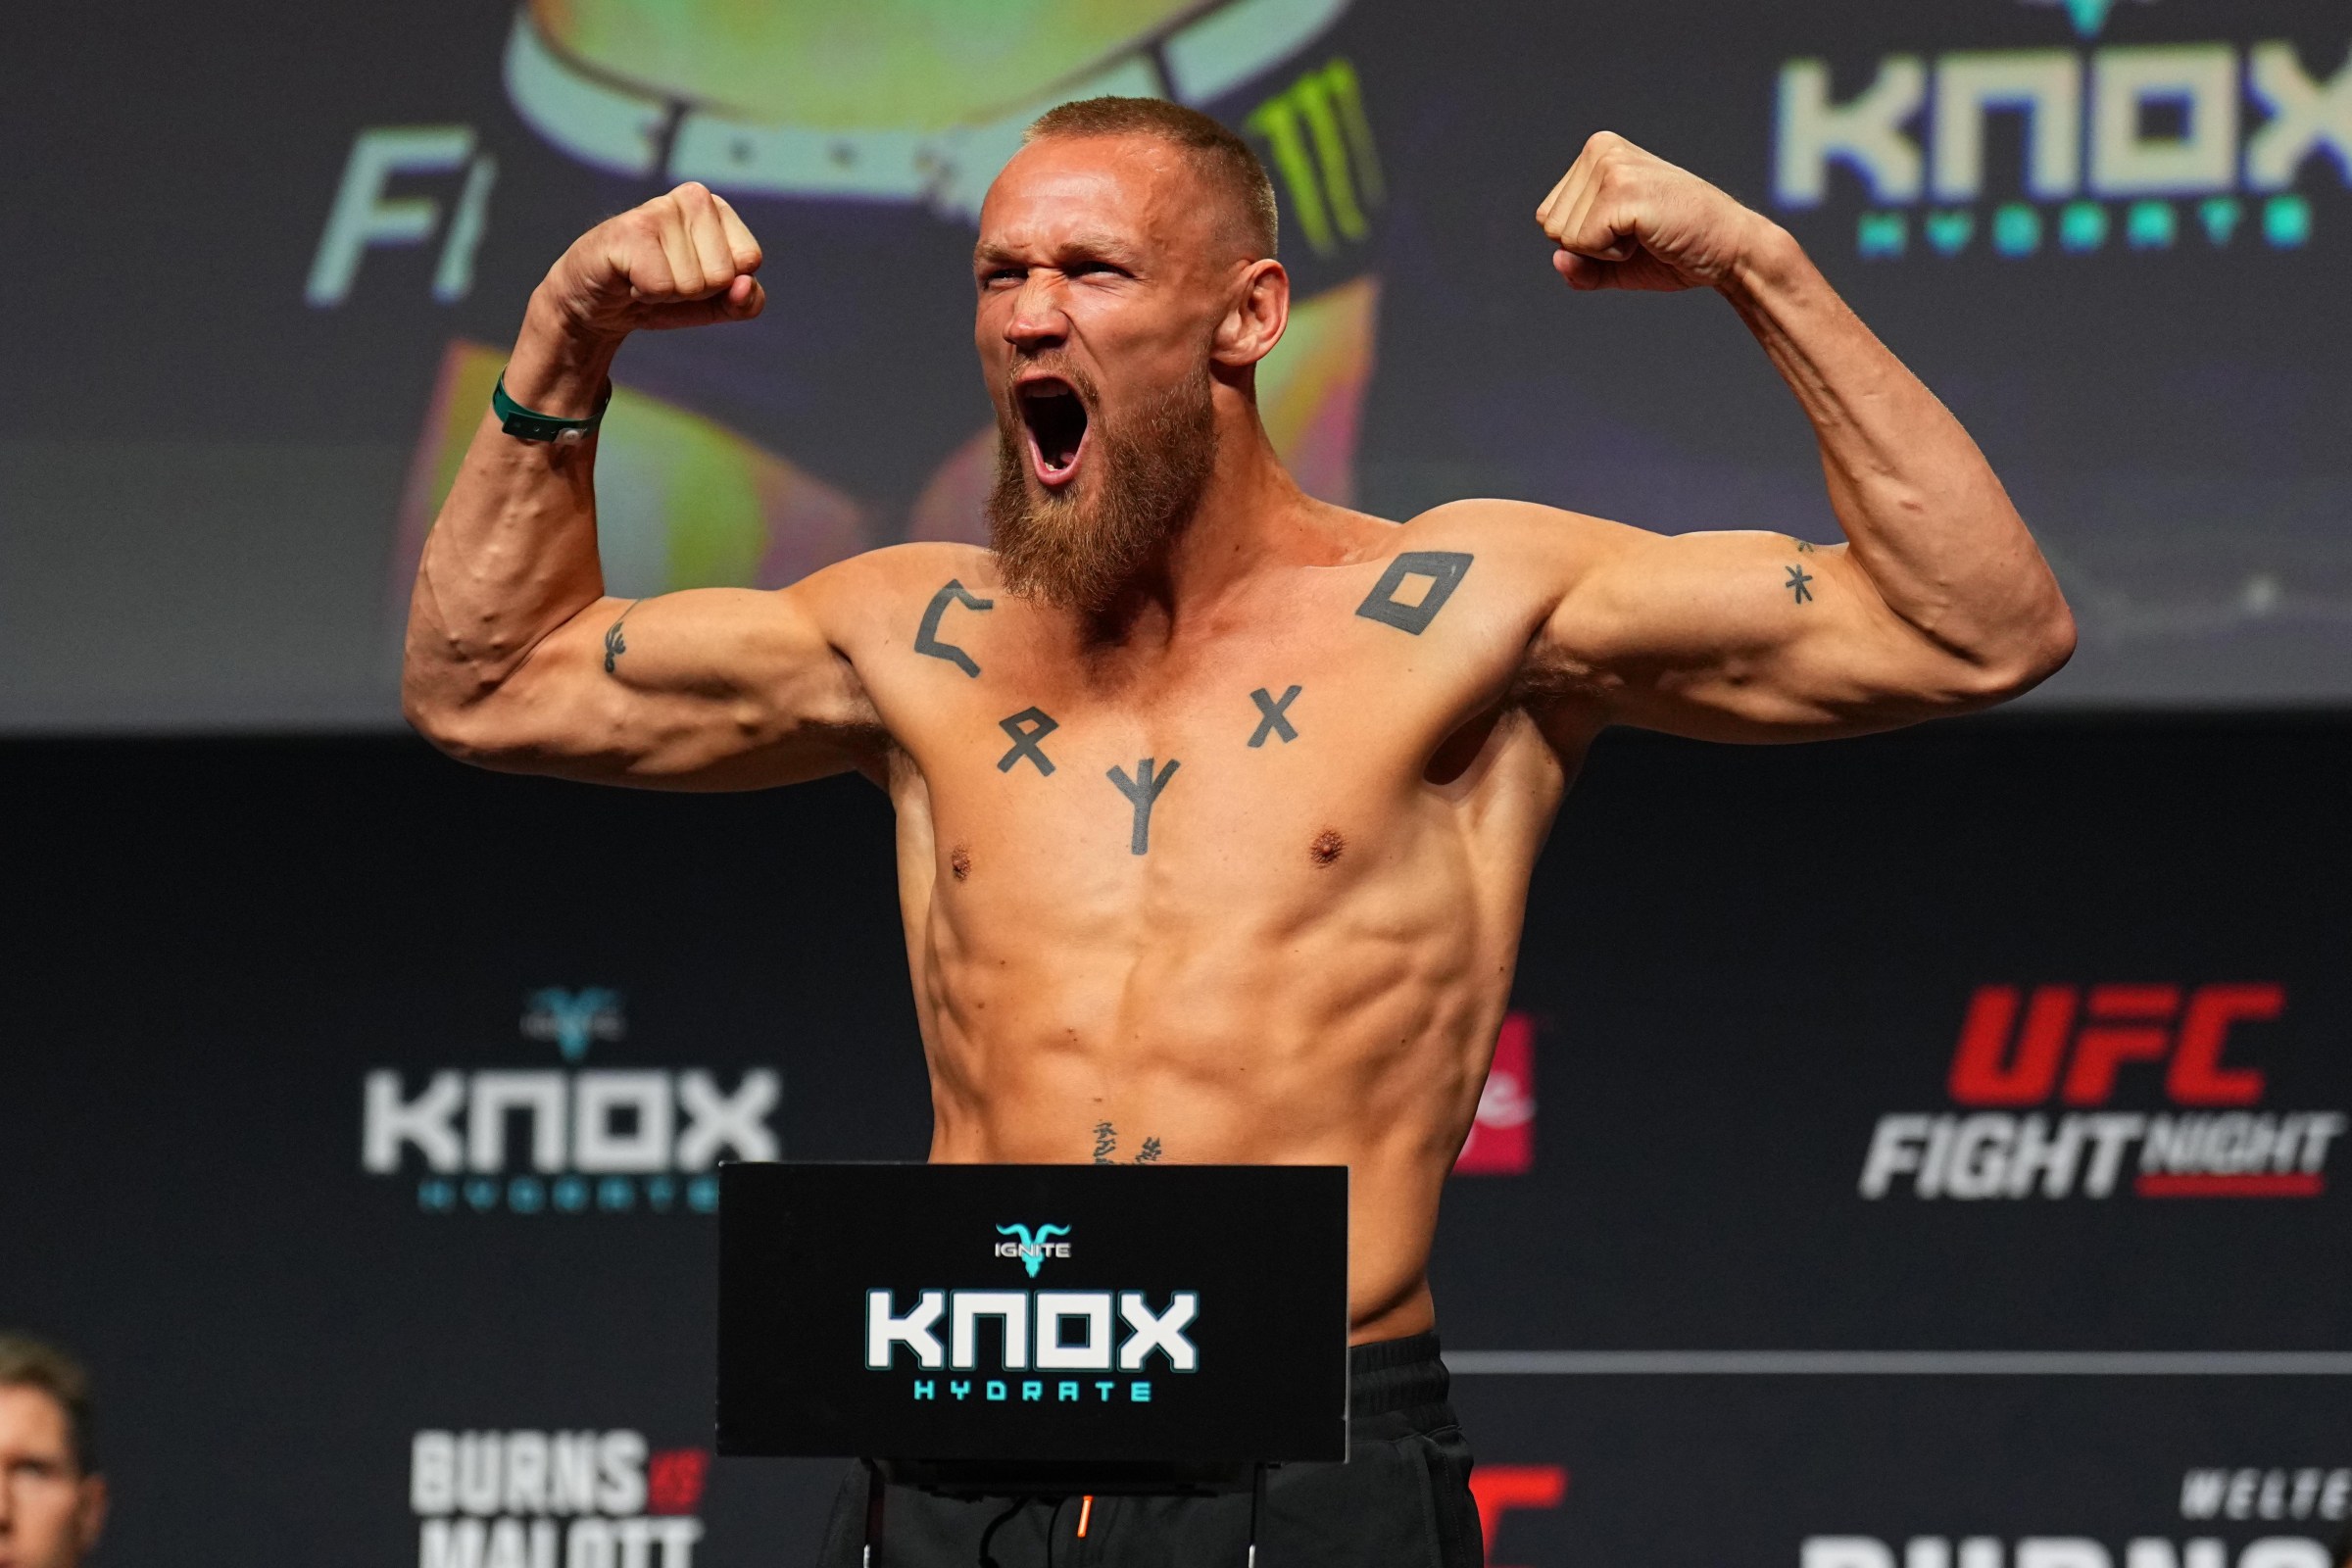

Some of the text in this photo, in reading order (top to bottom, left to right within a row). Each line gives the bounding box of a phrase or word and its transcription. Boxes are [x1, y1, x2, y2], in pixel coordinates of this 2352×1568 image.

[1772, 41, 2352, 207] KNOX
[1948, 986, 2284, 1105] UFC
[364, 1069, 780, 1173] KNOX
[1861, 1112, 2346, 1198] FIGHT NIGHT
[995, 1242, 1071, 1258] IGNITE
[865, 1289, 1199, 1371] KNOX
[913, 1380, 1152, 1402] HYDRATE
[412, 1430, 647, 1516] BURNS
